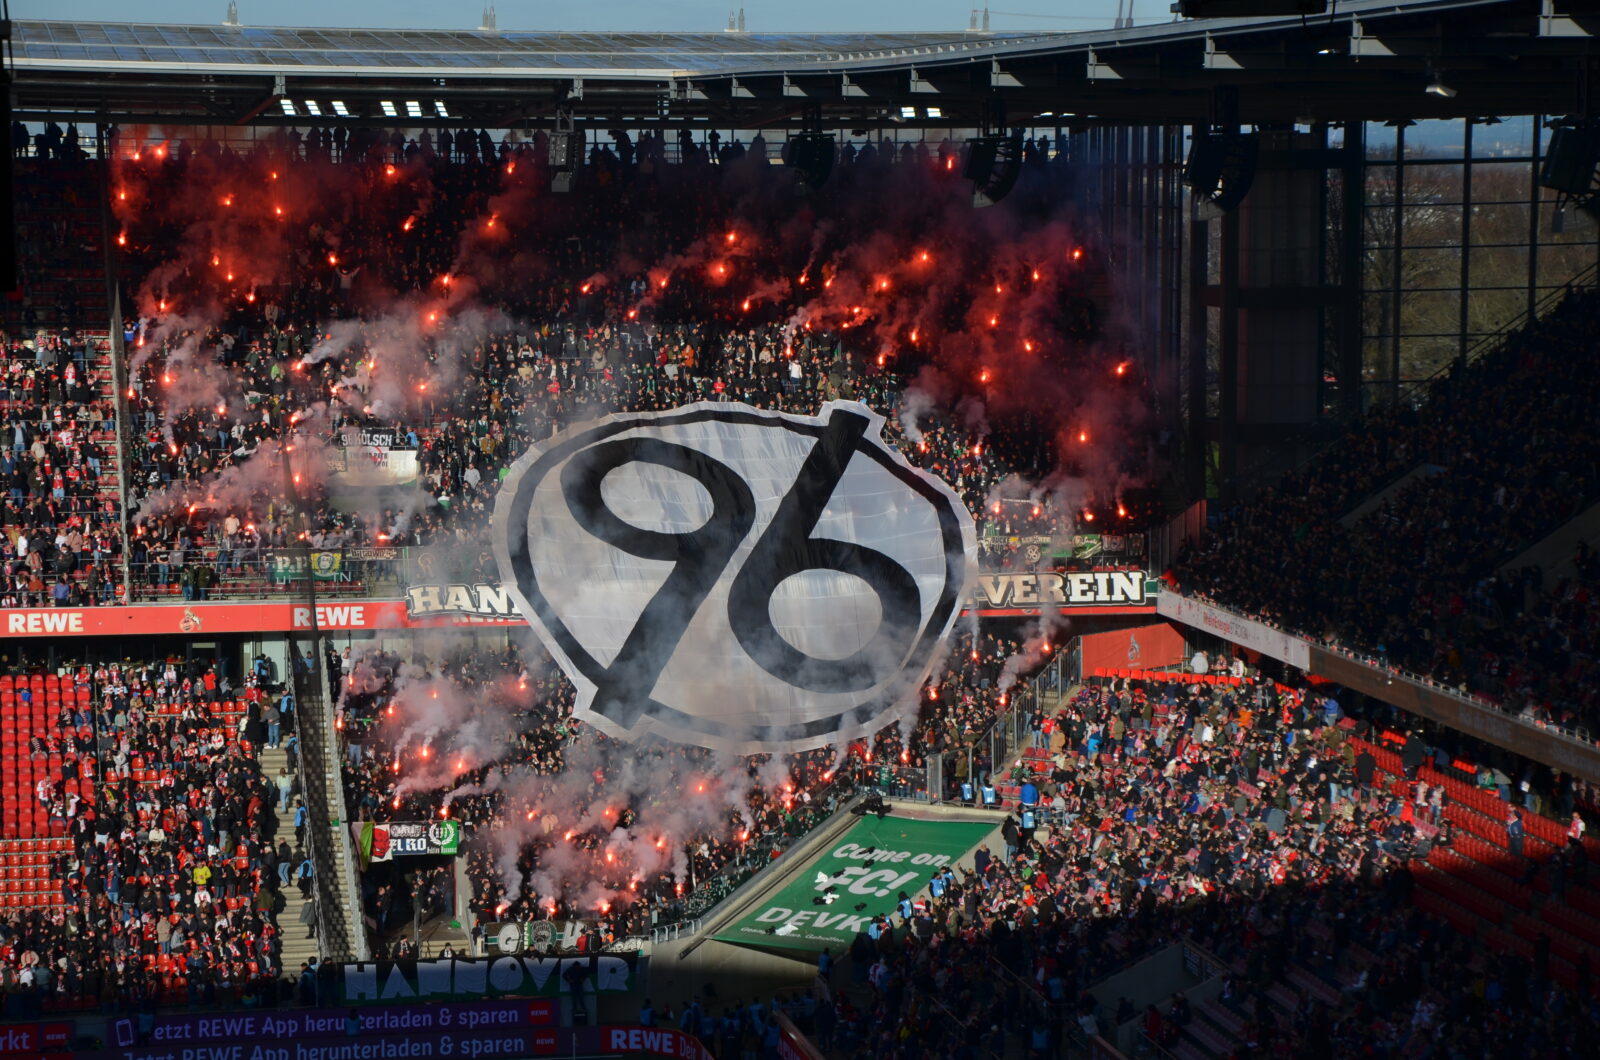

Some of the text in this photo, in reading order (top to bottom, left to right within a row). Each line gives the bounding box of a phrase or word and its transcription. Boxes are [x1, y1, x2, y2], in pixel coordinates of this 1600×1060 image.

[559, 409, 921, 729] 96
[410, 586, 522, 614] HAN
[9, 613, 84, 633] REWE
[294, 606, 366, 627] REWE
[833, 844, 911, 863] Come
[815, 866, 919, 897] FC!
[755, 907, 873, 933] DEVK
[344, 957, 630, 1001] HANNOVER
[154, 1008, 519, 1040] etzt REWE App heruterladen & sparen
[296, 1038, 432, 1060] herunterladen
[440, 1035, 454, 1055] &
[460, 1038, 525, 1058] sparen
[611, 1029, 674, 1053] REWE
